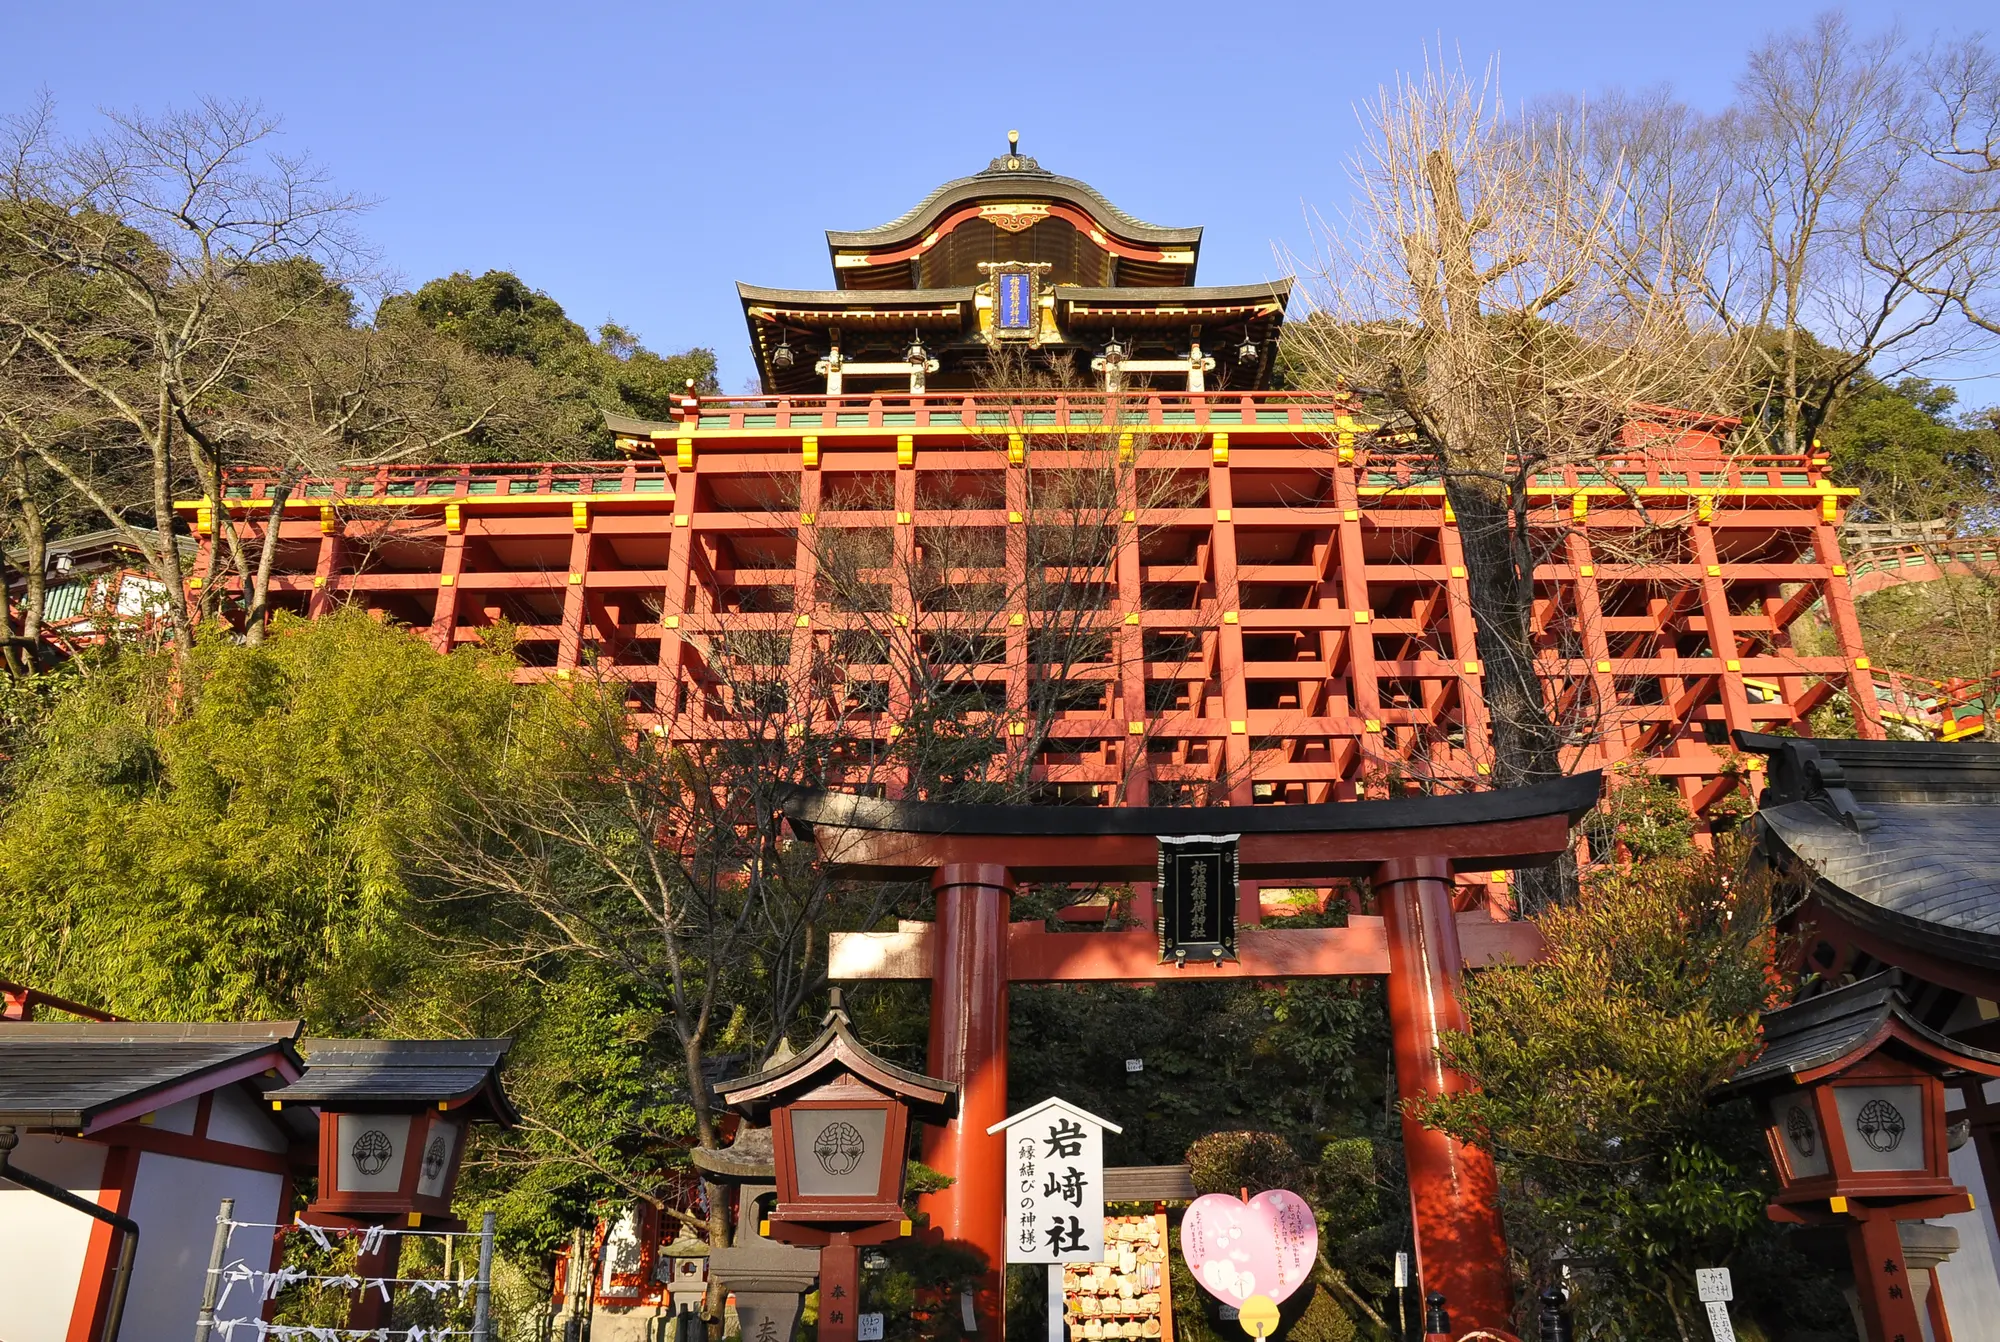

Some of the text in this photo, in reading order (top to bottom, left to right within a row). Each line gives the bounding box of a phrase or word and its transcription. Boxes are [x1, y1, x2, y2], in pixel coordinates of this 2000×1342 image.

[1702, 1271, 1723, 1285] さかき
[829, 1284, 846, 1325] 奉納
[861, 1316, 880, 1327] くろまつ
[863, 1327, 878, 1337] まつ科
